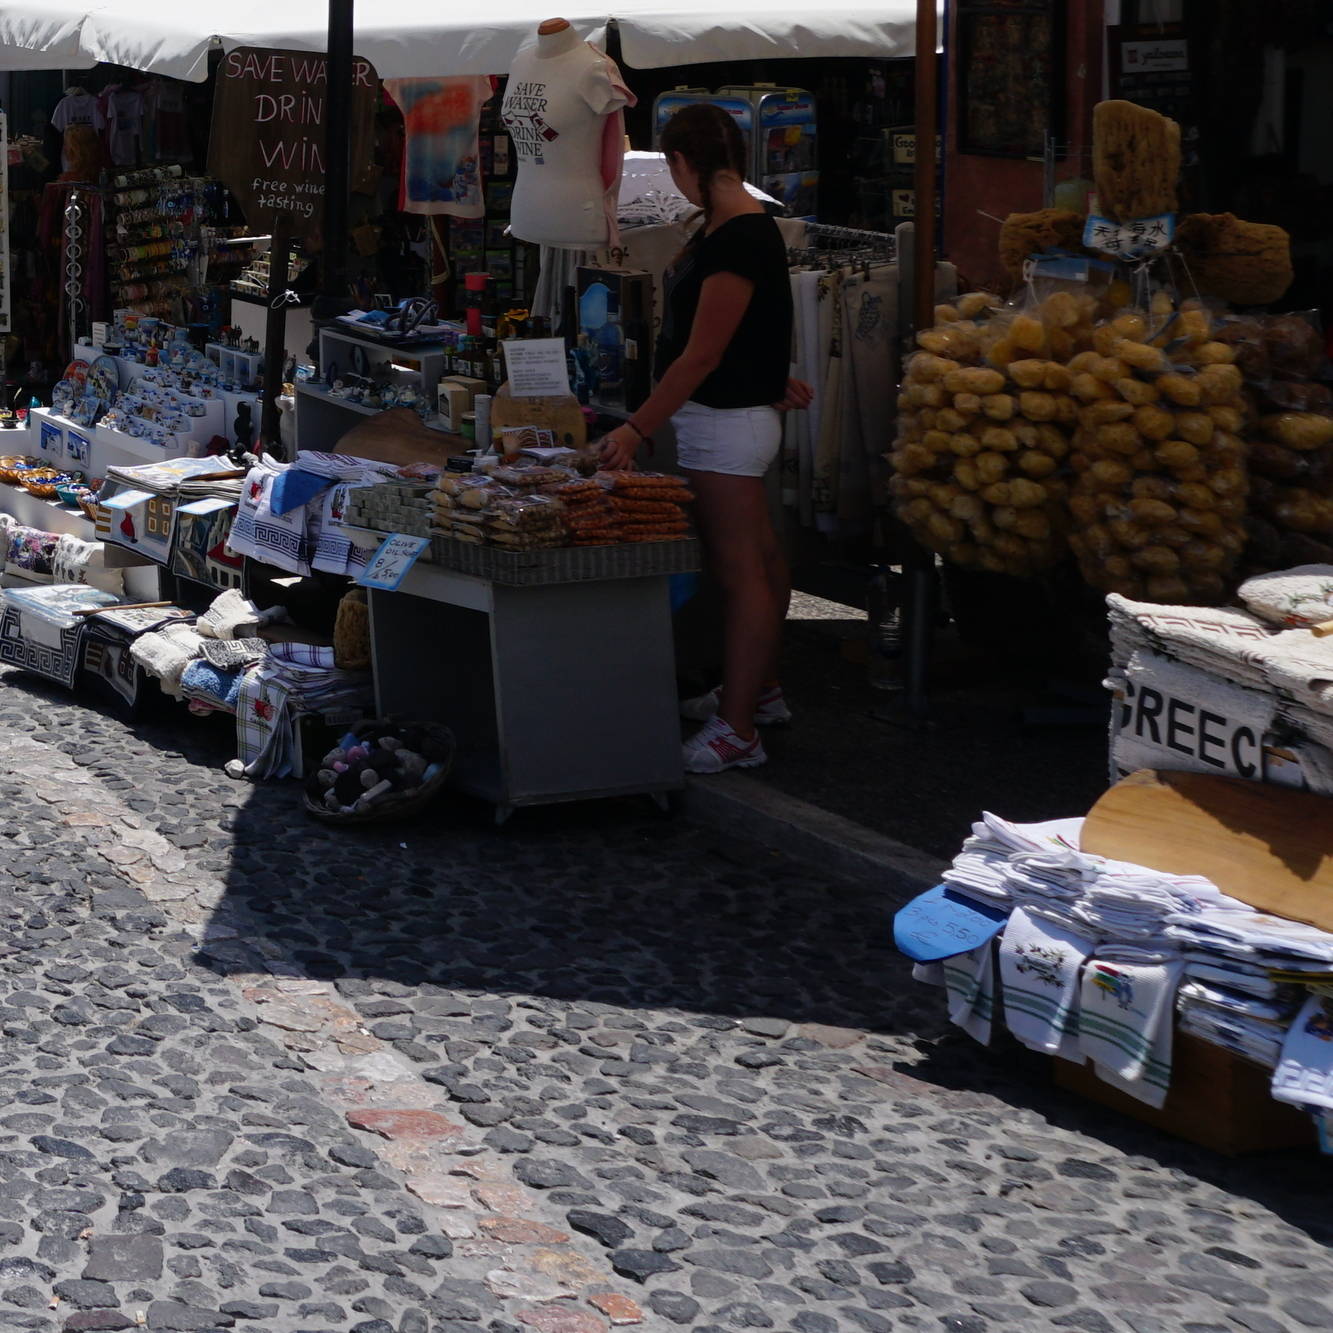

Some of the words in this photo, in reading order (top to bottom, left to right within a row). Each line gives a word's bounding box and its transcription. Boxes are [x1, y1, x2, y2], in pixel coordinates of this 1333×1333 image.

[225, 52, 285, 82] SAVE
[291, 57, 372, 87] WAR
[514, 82, 546, 97] SAVE
[254, 90, 323, 125] DRIN
[504, 96, 548, 112] WATER
[507, 125, 545, 142] DRINK
[259, 137, 325, 174] WIN
[251, 177, 287, 192] free
[293, 180, 325, 195] wine
[257, 194, 314, 218] tasting
[386, 548, 399, 556] OIL
[389, 539, 417, 548] OLIVE
